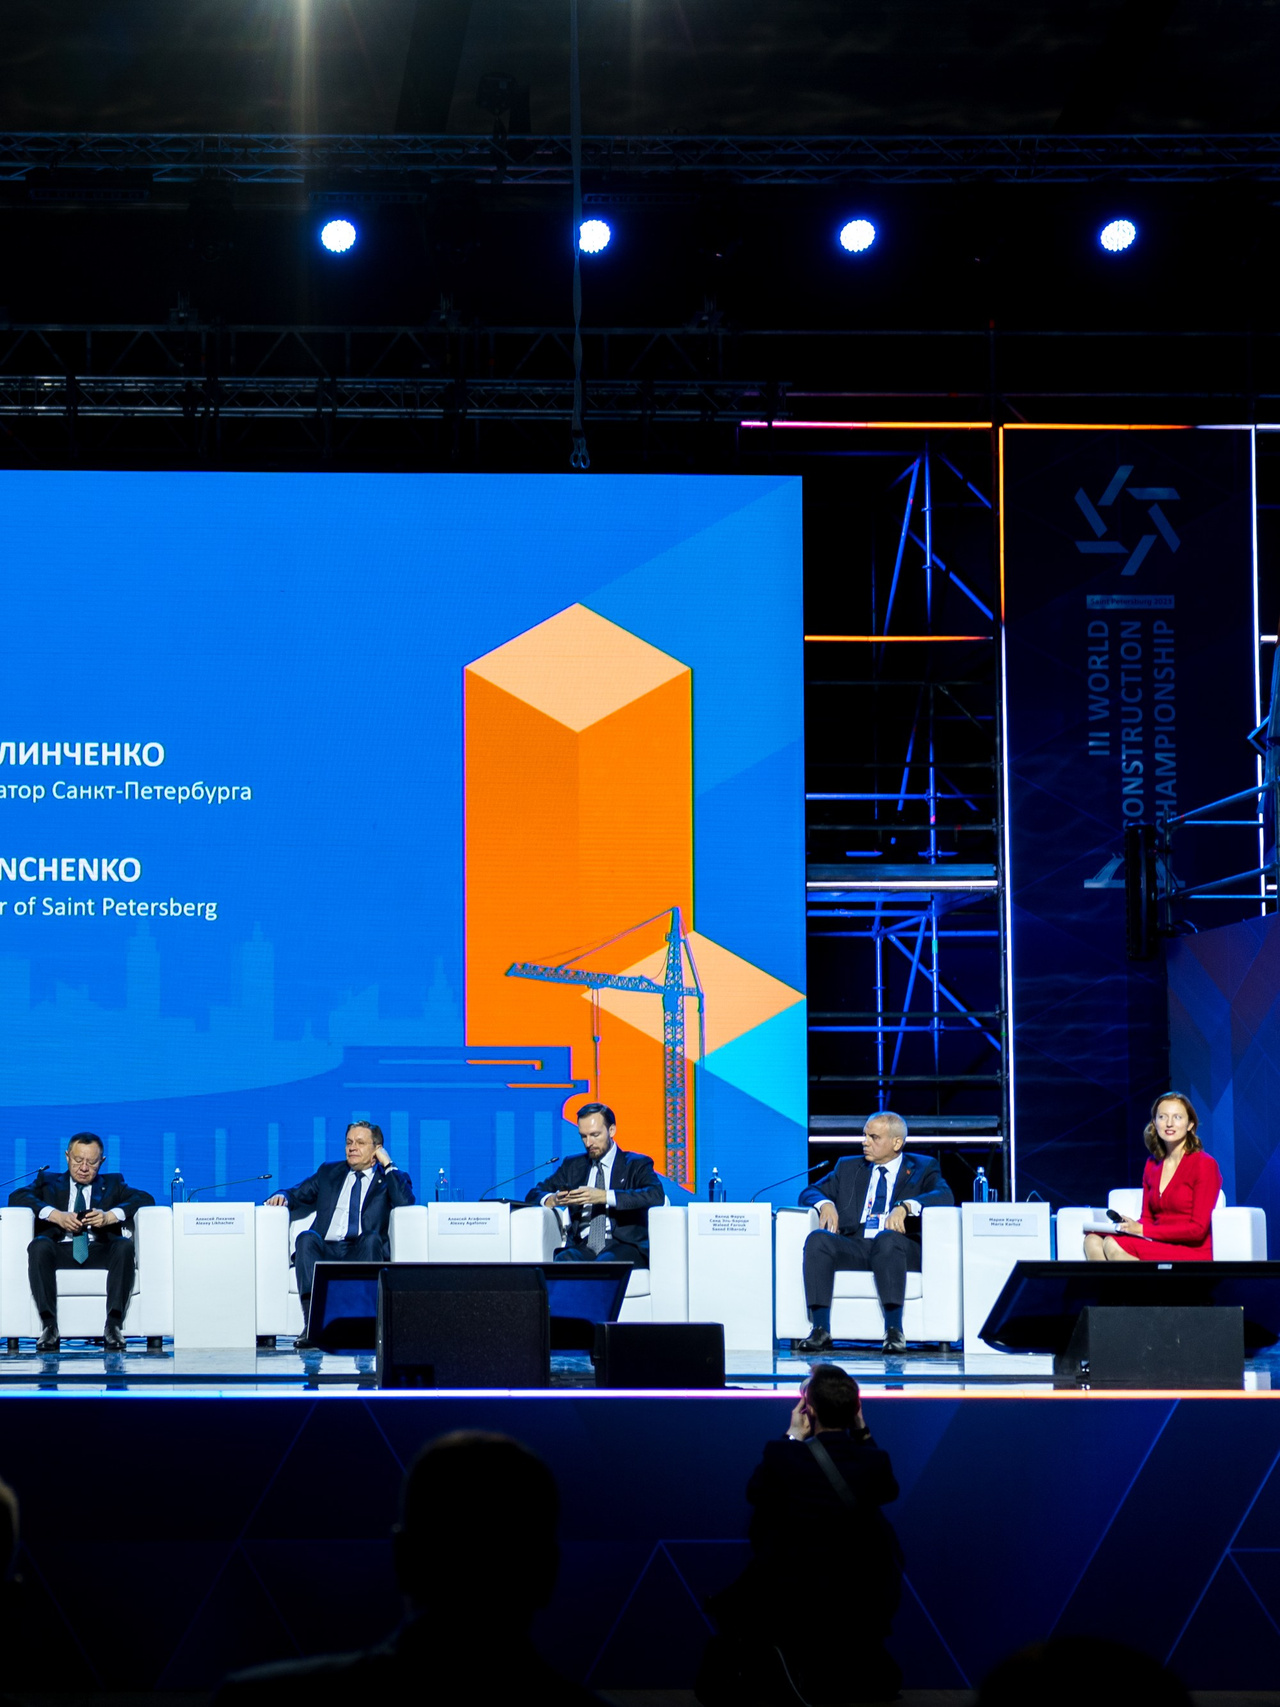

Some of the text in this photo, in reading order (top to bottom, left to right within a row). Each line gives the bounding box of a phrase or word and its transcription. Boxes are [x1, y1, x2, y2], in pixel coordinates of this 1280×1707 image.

[1086, 619, 1110, 757] III WORLD
[52, 781, 252, 805] Санкт-Петербурга
[13, 896, 37, 916] of
[42, 897, 95, 916] Saint
[102, 897, 218, 921] Petersberg
